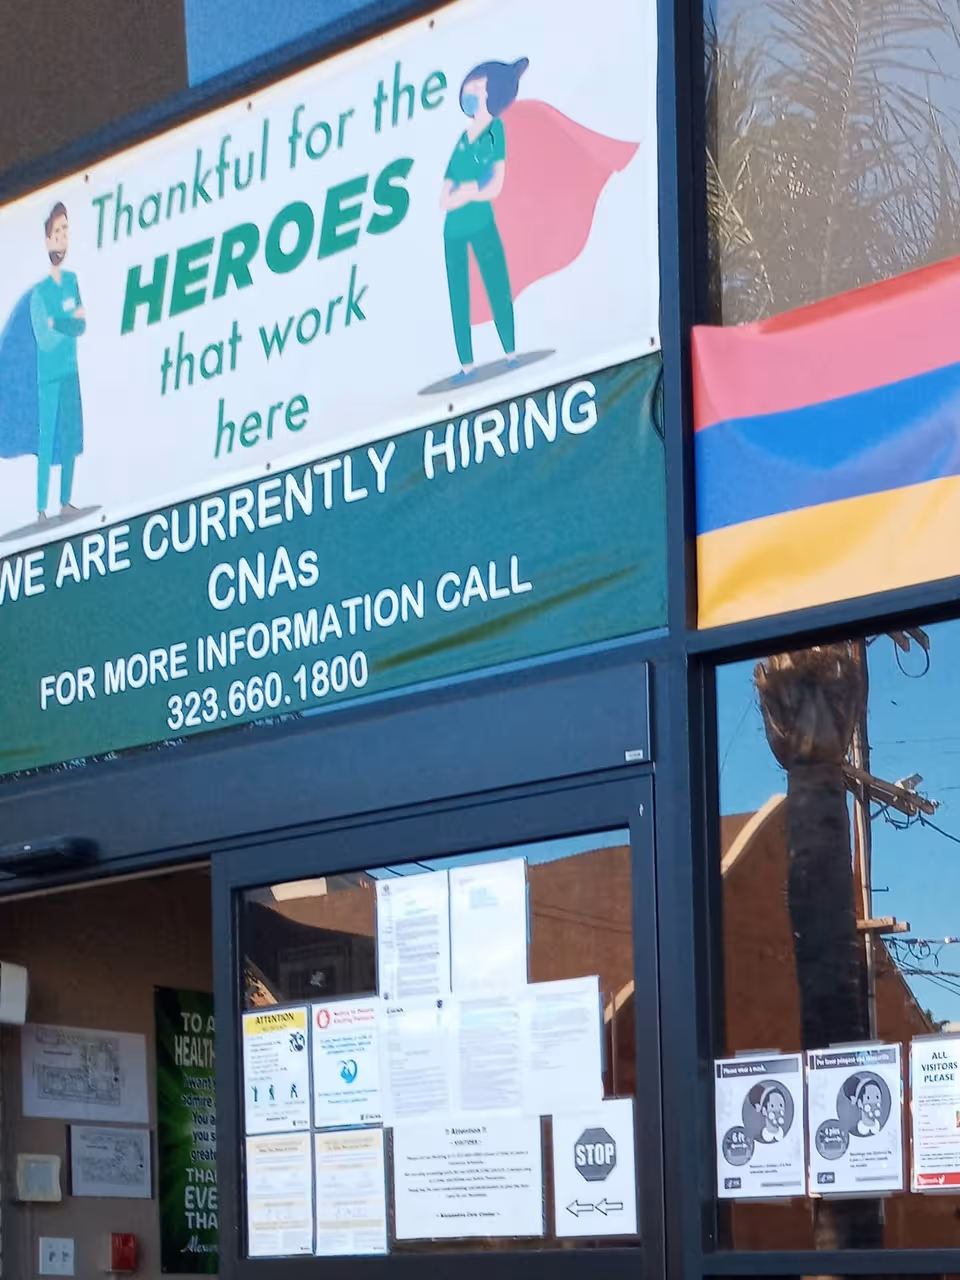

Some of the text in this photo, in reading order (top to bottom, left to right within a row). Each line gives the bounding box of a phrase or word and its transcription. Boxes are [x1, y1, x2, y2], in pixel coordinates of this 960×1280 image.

[92, 60, 447, 249] Thankful for the
[121, 157, 415, 336] HEROES
[160, 264, 370, 396] that work
[214, 393, 309, 459] here
[55, 524, 131, 589] ARE
[142, 441, 397, 561] CURRENTLY
[423, 380, 599, 480] HIRING
[207, 546, 320, 611] CNAs
[40, 554, 533, 711] FOR MORE INFORMATION CALL
[167, 650, 369, 731] 323.660.1800
[180, 1011, 202, 1034] TO
[255, 1012, 295, 1025] ATTENTION
[921, 1062, 958, 1072] VISITORS
[931, 1052, 948, 1060] ALL
[924, 1073, 954, 1083] PLEASE
[191, 1111, 208, 1126] You
[191, 1131, 209, 1144] you
[731, 1132, 738, 1142] 6
[575, 1142, 614, 1167] STOP
